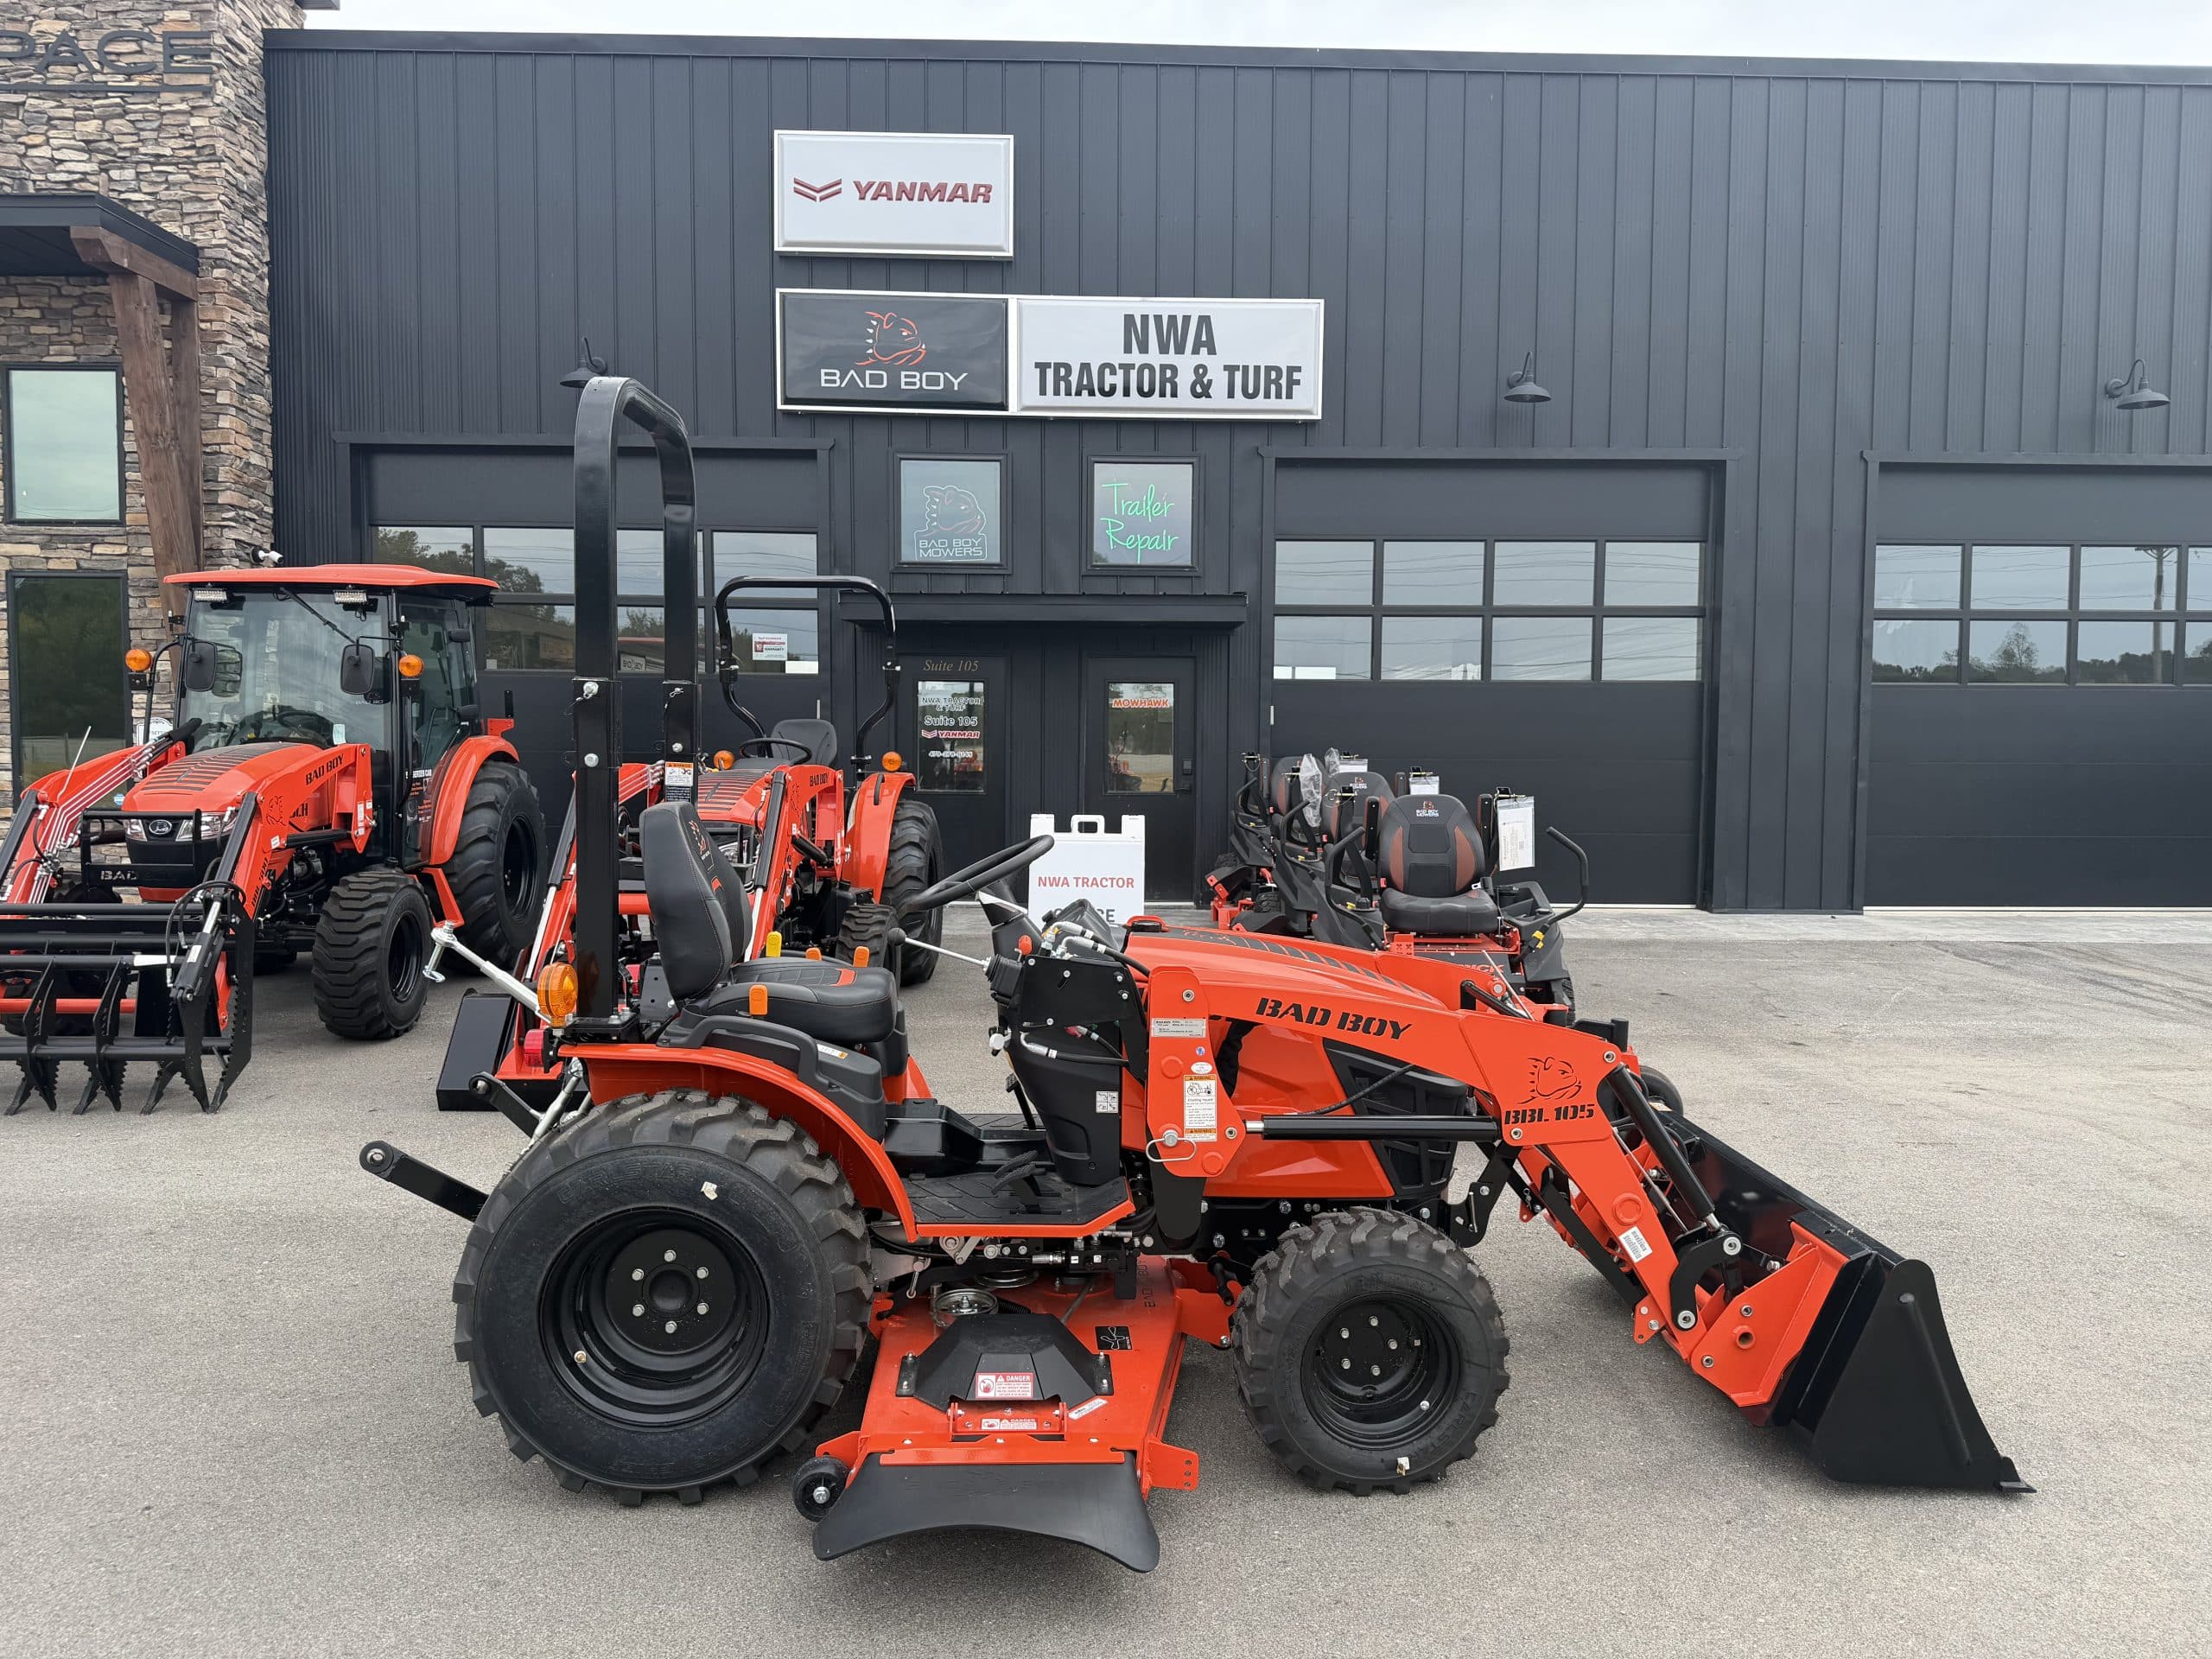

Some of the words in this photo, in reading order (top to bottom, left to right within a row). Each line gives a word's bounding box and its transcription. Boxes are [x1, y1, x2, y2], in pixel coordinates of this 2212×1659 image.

[853, 180, 993, 204] YANMAR
[1122, 313, 1217, 356] NWA
[820, 368, 887, 390] BAD
[900, 371, 969, 391] BOY
[1034, 361, 1179, 399] TRACTOR
[1189, 364, 1214, 399] &
[1223, 363, 1302, 400] TURF
[1101, 483, 1175, 523] Trailer
[918, 539, 948, 548] BAD
[952, 537, 982, 547] BOY
[919, 547, 982, 557] MOWERS
[1100, 518, 1179, 564] Repair
[923, 659, 954, 671] Suite
[957, 660, 979, 671] 105
[944, 696, 982, 705] TRACTOR
[1112, 698, 1170, 709] MOWHAWK
[924, 715, 955, 726] Suite
[957, 716, 978, 726] 105
[938, 730, 981, 739] YANMAR
[305, 766, 325, 786] BAD
[326, 753, 344, 772] BOY
[1037, 875, 1071, 888] NWA
[1073, 875, 1135, 889] TRACTOR
[1255, 997, 1332, 1027] BAD
[1337, 1012, 1413, 1040] BOY
[1504, 1108, 1549, 1125] BBL
[1554, 1103, 1595, 1121] 105
